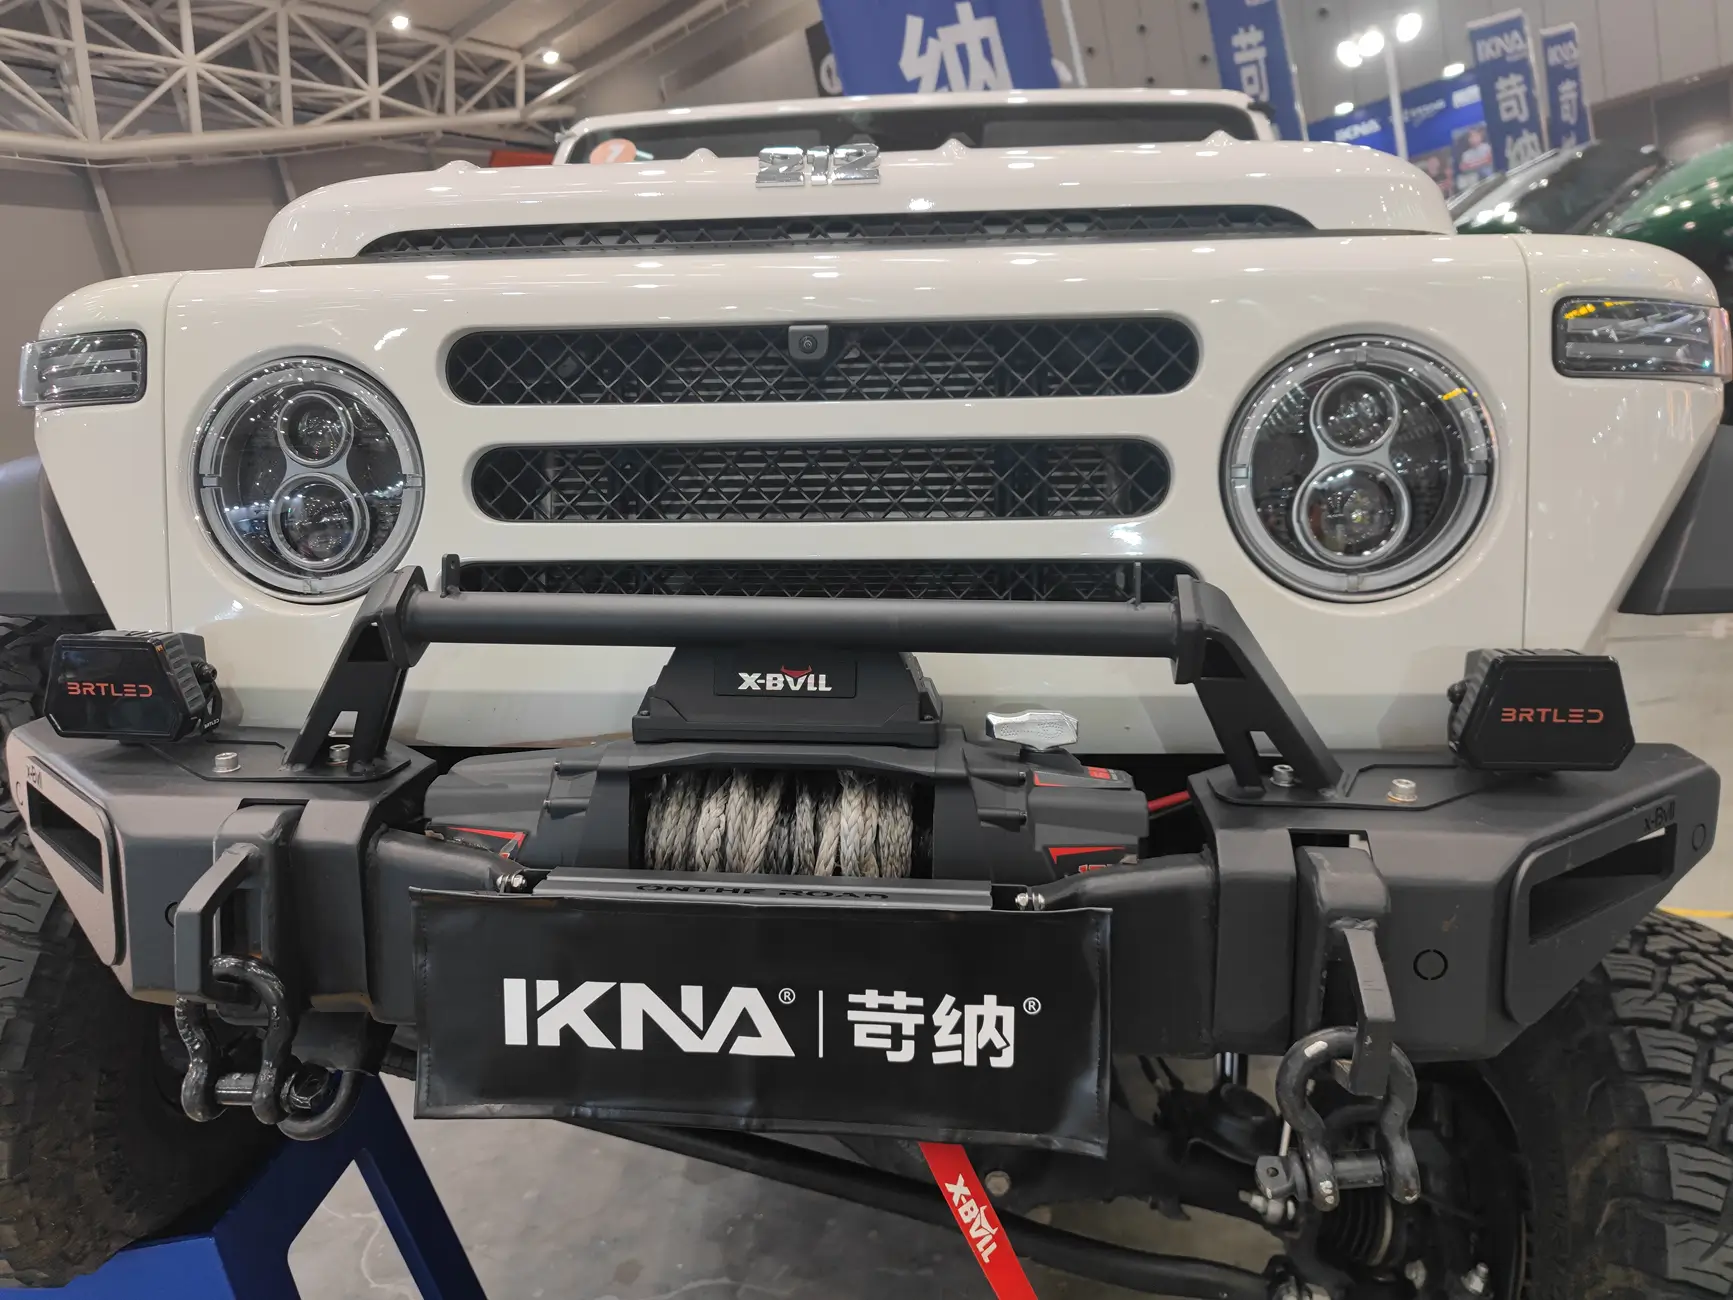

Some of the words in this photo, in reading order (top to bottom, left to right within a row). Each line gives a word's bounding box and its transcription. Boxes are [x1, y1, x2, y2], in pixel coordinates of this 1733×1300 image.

[898, 1, 1014, 93] 纳
[756, 142, 880, 188] 212
[67, 682, 153, 698] BRTLED
[1501, 707, 1603, 724] BRTLED
